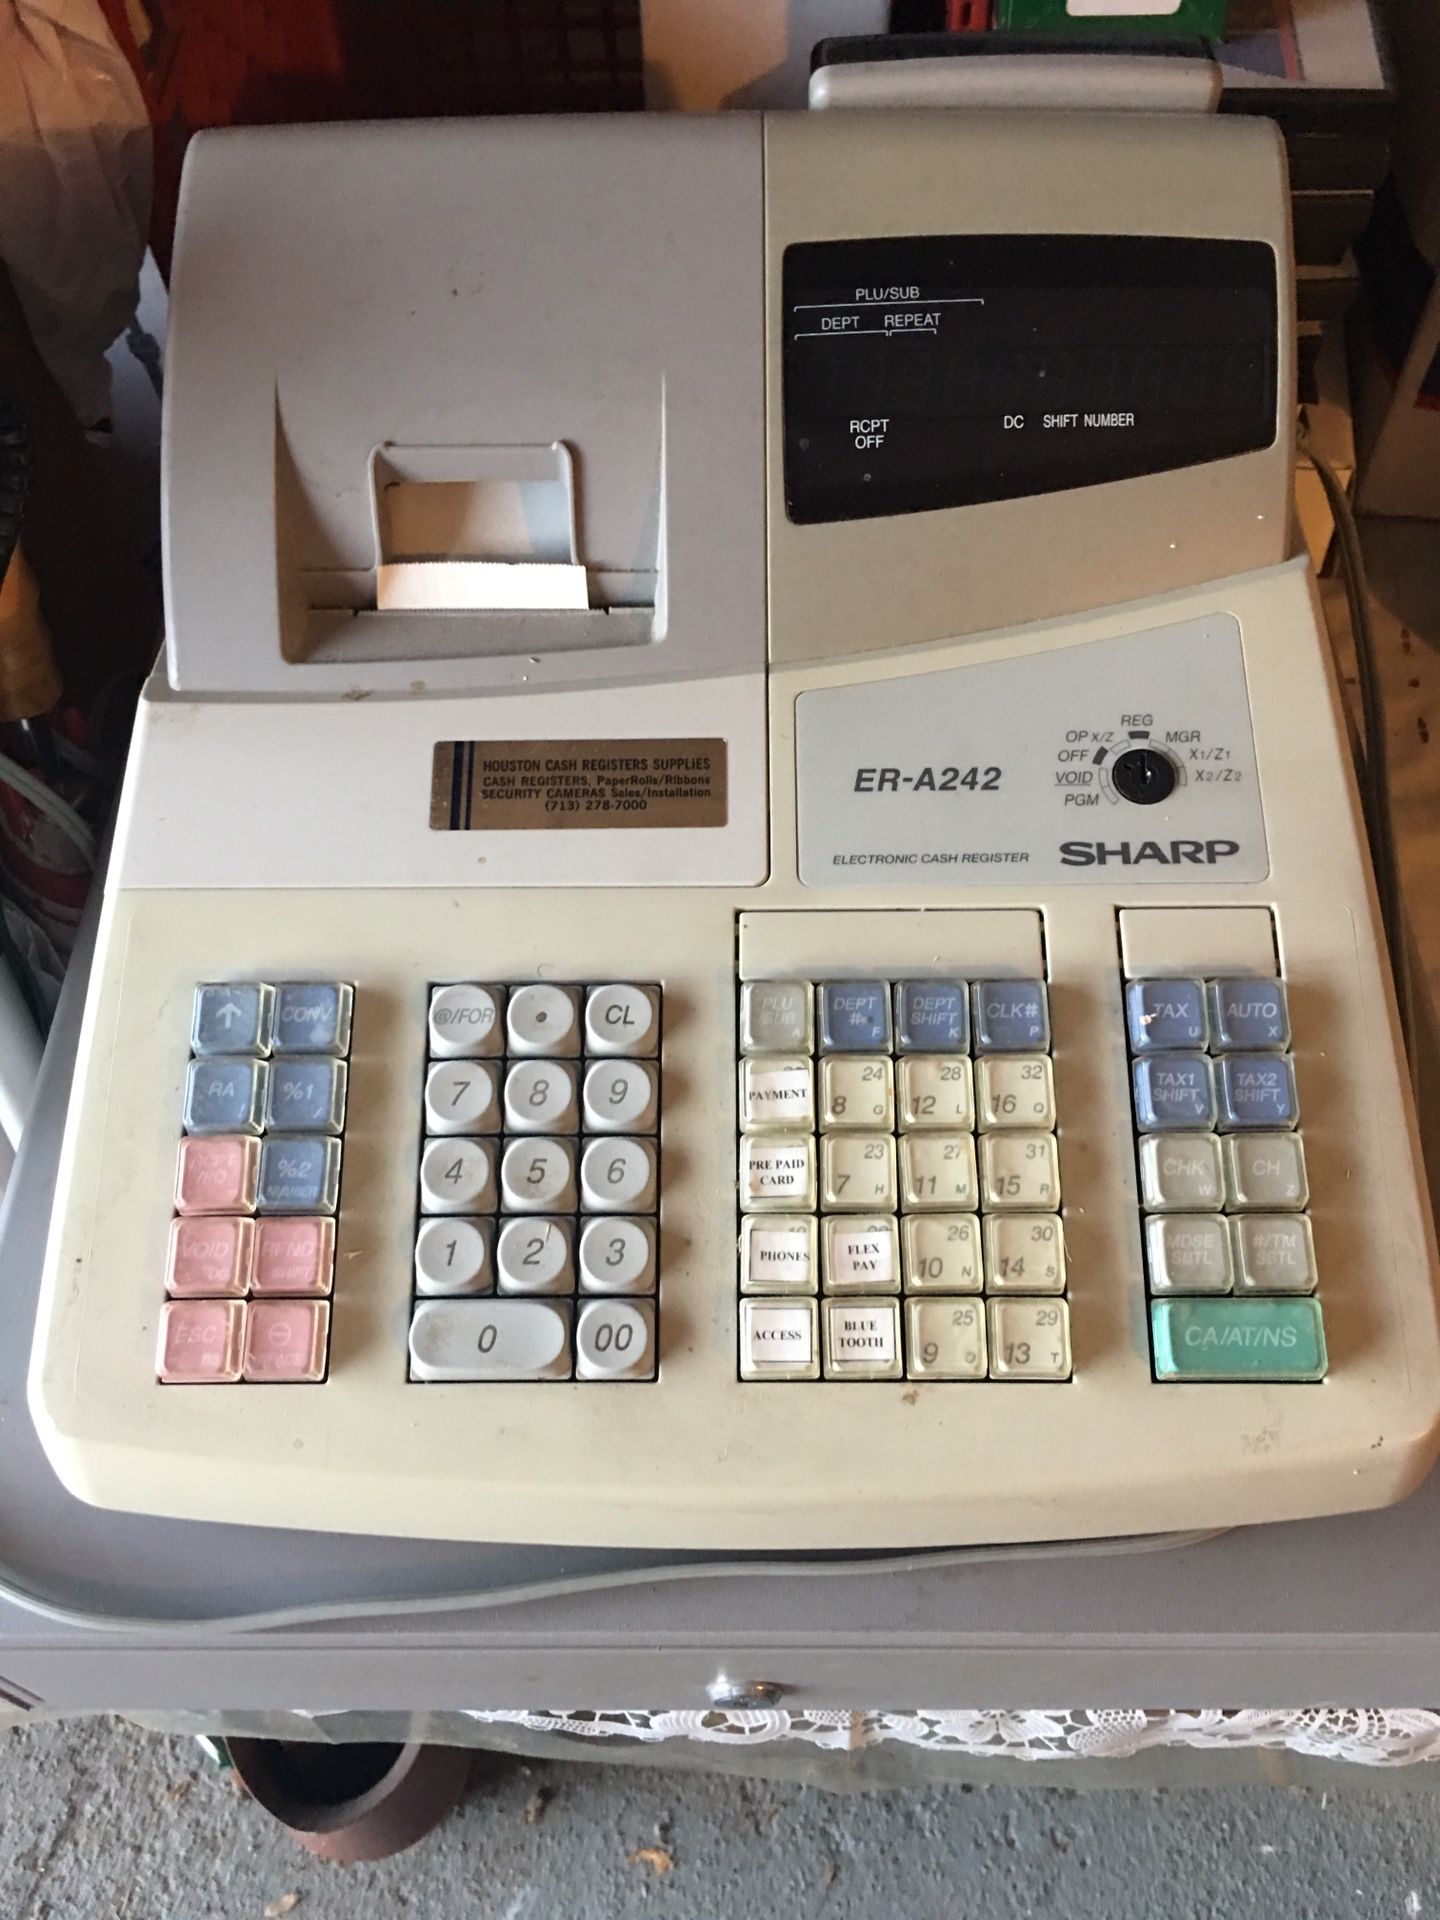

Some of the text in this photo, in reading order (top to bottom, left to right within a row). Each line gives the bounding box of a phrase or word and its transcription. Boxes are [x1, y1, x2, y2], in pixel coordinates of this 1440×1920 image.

[855, 287, 920, 301] PLU/SUB
[821, 315, 860, 330] DEPT
[884, 313, 941, 327] REPEAT
[850, 419, 889, 433] RCPT
[1004, 415, 1024, 429] DC
[1043, 412, 1134, 428] SHIFT NUMBER
[855, 435, 884, 449] OFF
[1121, 714, 1153, 727] REG
[1065, 730, 1088, 743] OP
[1165, 731, 1201, 743] MGR
[1057, 750, 1089, 762] OFF
[483, 757, 711, 772] HOUSTON CASH REGISTERS SUPPLIES
[483, 776, 515, 787] CASH
[854, 767, 1002, 793] ER-A242
[1055, 771, 1093, 783] VOID
[482, 787, 711, 799] SECURITY CAMERAS Sales/Installation
[1064, 793, 1100, 806] PGM
[545, 799, 648, 812] (713) 278-7000
[833, 852, 1029, 865] ELECTRONIC CASH REGISTER
[1059, 840, 1240, 867] SHARP
[833, 996, 876, 1011] DEPT
[913, 996, 957, 1010] DEPT
[986, 1002, 1039, 1018] CLK#
[1153, 1003, 1188, 1018] TAX
[1226, 1002, 1278, 1018] AUTO
[433, 1008, 494, 1026] @/FOR
[605, 1004, 635, 1025] CL
[910, 1012, 958, 1025] SHIFT
[872, 1026, 881, 1038] F
[949, 1027, 959, 1038] K
[1029, 1026, 1039, 1037] P
[1188, 1026, 1199, 1037] U
[1268, 1026, 1279, 1037] X
[861, 1066, 883, 1081] 24
[940, 1066, 962, 1081] 28
[1021, 1065, 1043, 1080] 32
[1156, 1072, 1195, 1087] TAX1
[1236, 1072, 1278, 1087] TAX2
[284, 1082, 314, 1100] %1
[450, 1080, 471, 1107] 7
[528, 1079, 550, 1107] 8
[608, 1079, 629, 1105] 9
[749, 1088, 808, 1101] PAYMENT
[1153, 1088, 1200, 1101] SHIFT
[1234, 1088, 1281, 1101] SHIFT
[832, 1096, 847, 1115] 8
[873, 1104, 884, 1115] G
[912, 1096, 936, 1115] 12
[956, 1104, 963, 1114] L
[992, 1094, 1017, 1114] 16
[1194, 1104, 1205, 1115] V
[1276, 1104, 1286, 1115] Y
[864, 1144, 884, 1159] 23
[943, 1144, 961, 1160] 27
[1025, 1143, 1046, 1159] 31
[278, 1159, 312, 1179] %2
[444, 1158, 464, 1184] 4
[527, 1158, 548, 1184] 5
[607, 1158, 626, 1184] 6
[749, 1159, 805, 1170] PRE PAID
[1163, 1160, 1206, 1176] CHK
[1252, 1160, 1280, 1176] CH
[760, 1175, 794, 1185] CARD
[836, 1174, 851, 1194] 7
[915, 1175, 937, 1195] 11
[996, 1175, 1021, 1195] 15
[874, 1184, 885, 1194] H
[955, 1183, 967, 1194] M
[1040, 1183, 1050, 1195] R
[1285, 1184, 1296, 1196] Z
[947, 1225, 970, 1241] 26
[1031, 1226, 1053, 1241] 30
[446, 1240, 457, 1266] 1
[522, 1238, 545, 1265] 2
[605, 1238, 626, 1266] 3
[760, 1250, 811, 1262] PHONES
[848, 1244, 880, 1255] FLEX
[853, 1260, 878, 1271] PAY
[918, 1257, 944, 1278] 10
[962, 1266, 972, 1277] N
[1000, 1256, 1025, 1278] 14
[844, 1320, 878, 1331] BLUE
[952, 1310, 974, 1326] 25
[1035, 1310, 1058, 1326] 29
[477, 1324, 498, 1354] 0
[594, 1323, 633, 1352] 00
[753, 1330, 802, 1341] ACCESS
[838, 1337, 884, 1348] TOOTH
[1184, 1326, 1298, 1348] CA/AT/NS
[922, 1342, 939, 1364] 9
[1006, 1342, 1031, 1364] 13
[1051, 1352, 1060, 1363] T
